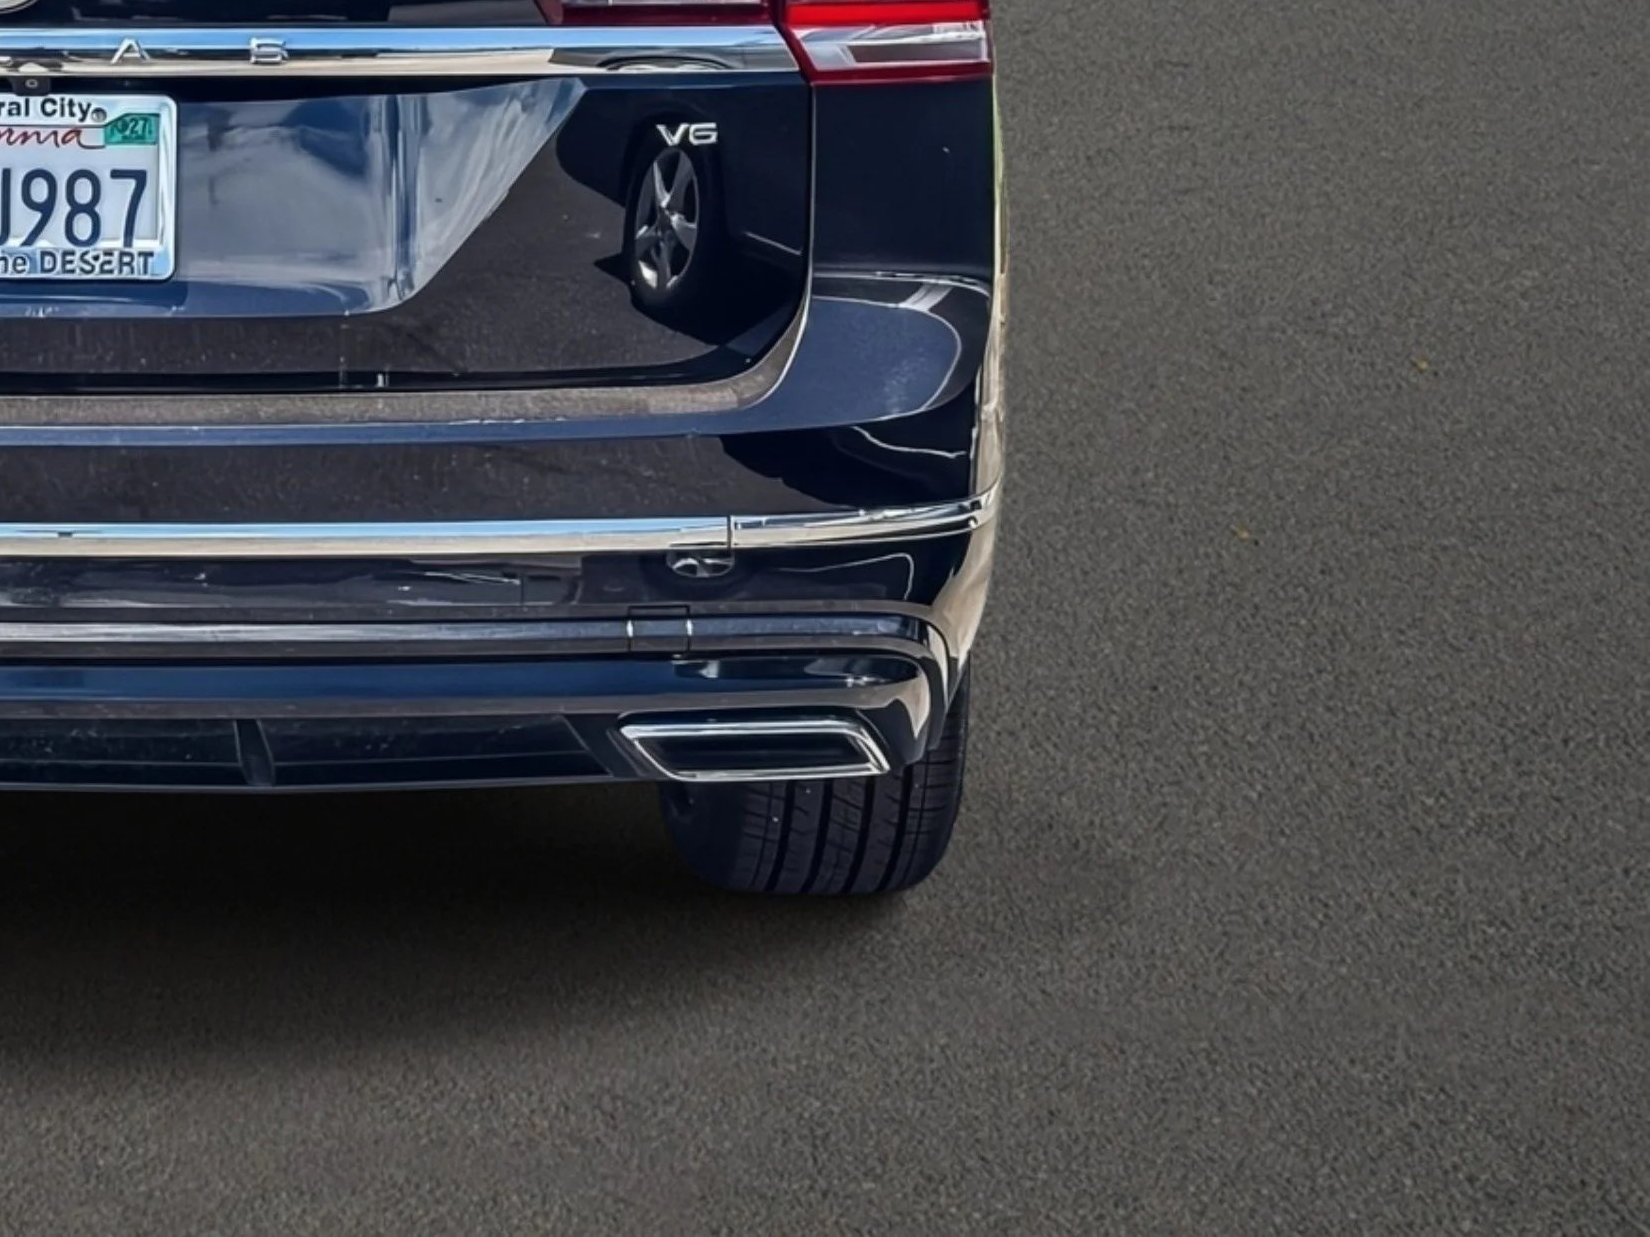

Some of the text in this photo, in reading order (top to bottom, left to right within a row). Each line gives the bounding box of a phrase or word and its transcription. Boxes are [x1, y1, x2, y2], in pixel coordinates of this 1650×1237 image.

[40, 98, 92, 122] City
[656, 122, 717, 146] V6
[40, 250, 154, 275] DESERT
